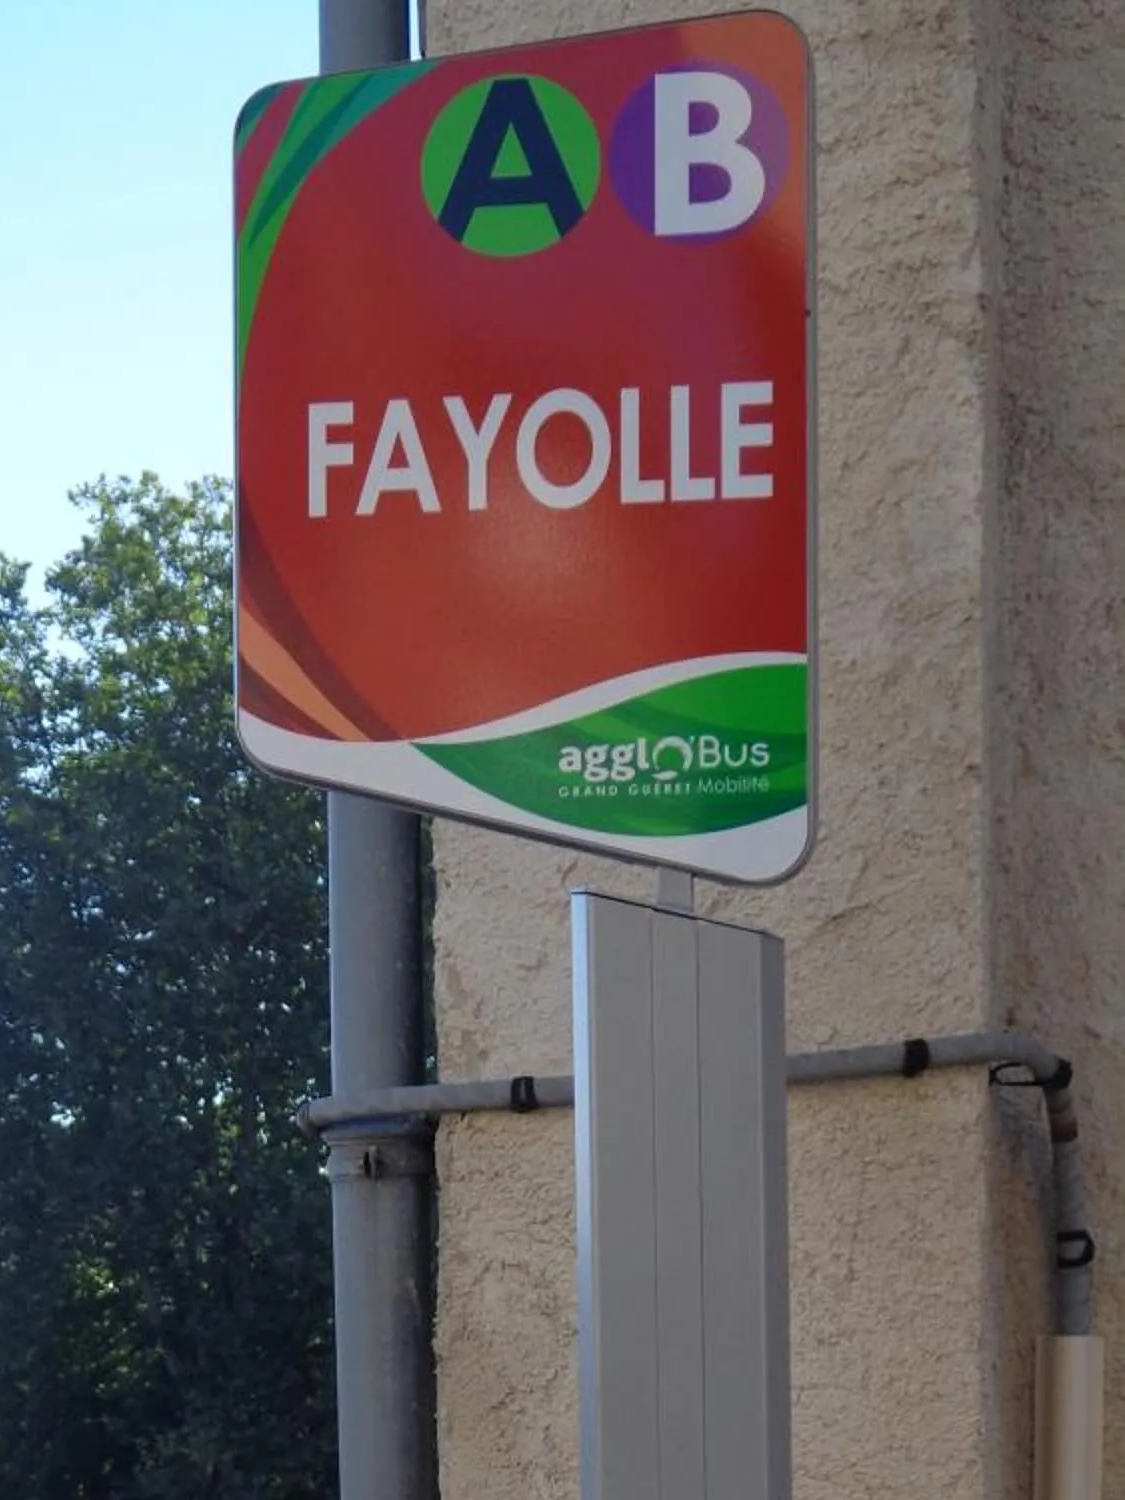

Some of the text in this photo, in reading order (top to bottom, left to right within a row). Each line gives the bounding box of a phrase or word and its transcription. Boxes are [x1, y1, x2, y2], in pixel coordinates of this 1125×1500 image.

[438, 70, 766, 241] A B
[307, 381, 774, 518] FAYOLLE
[558, 786, 618, 798] GRAND
